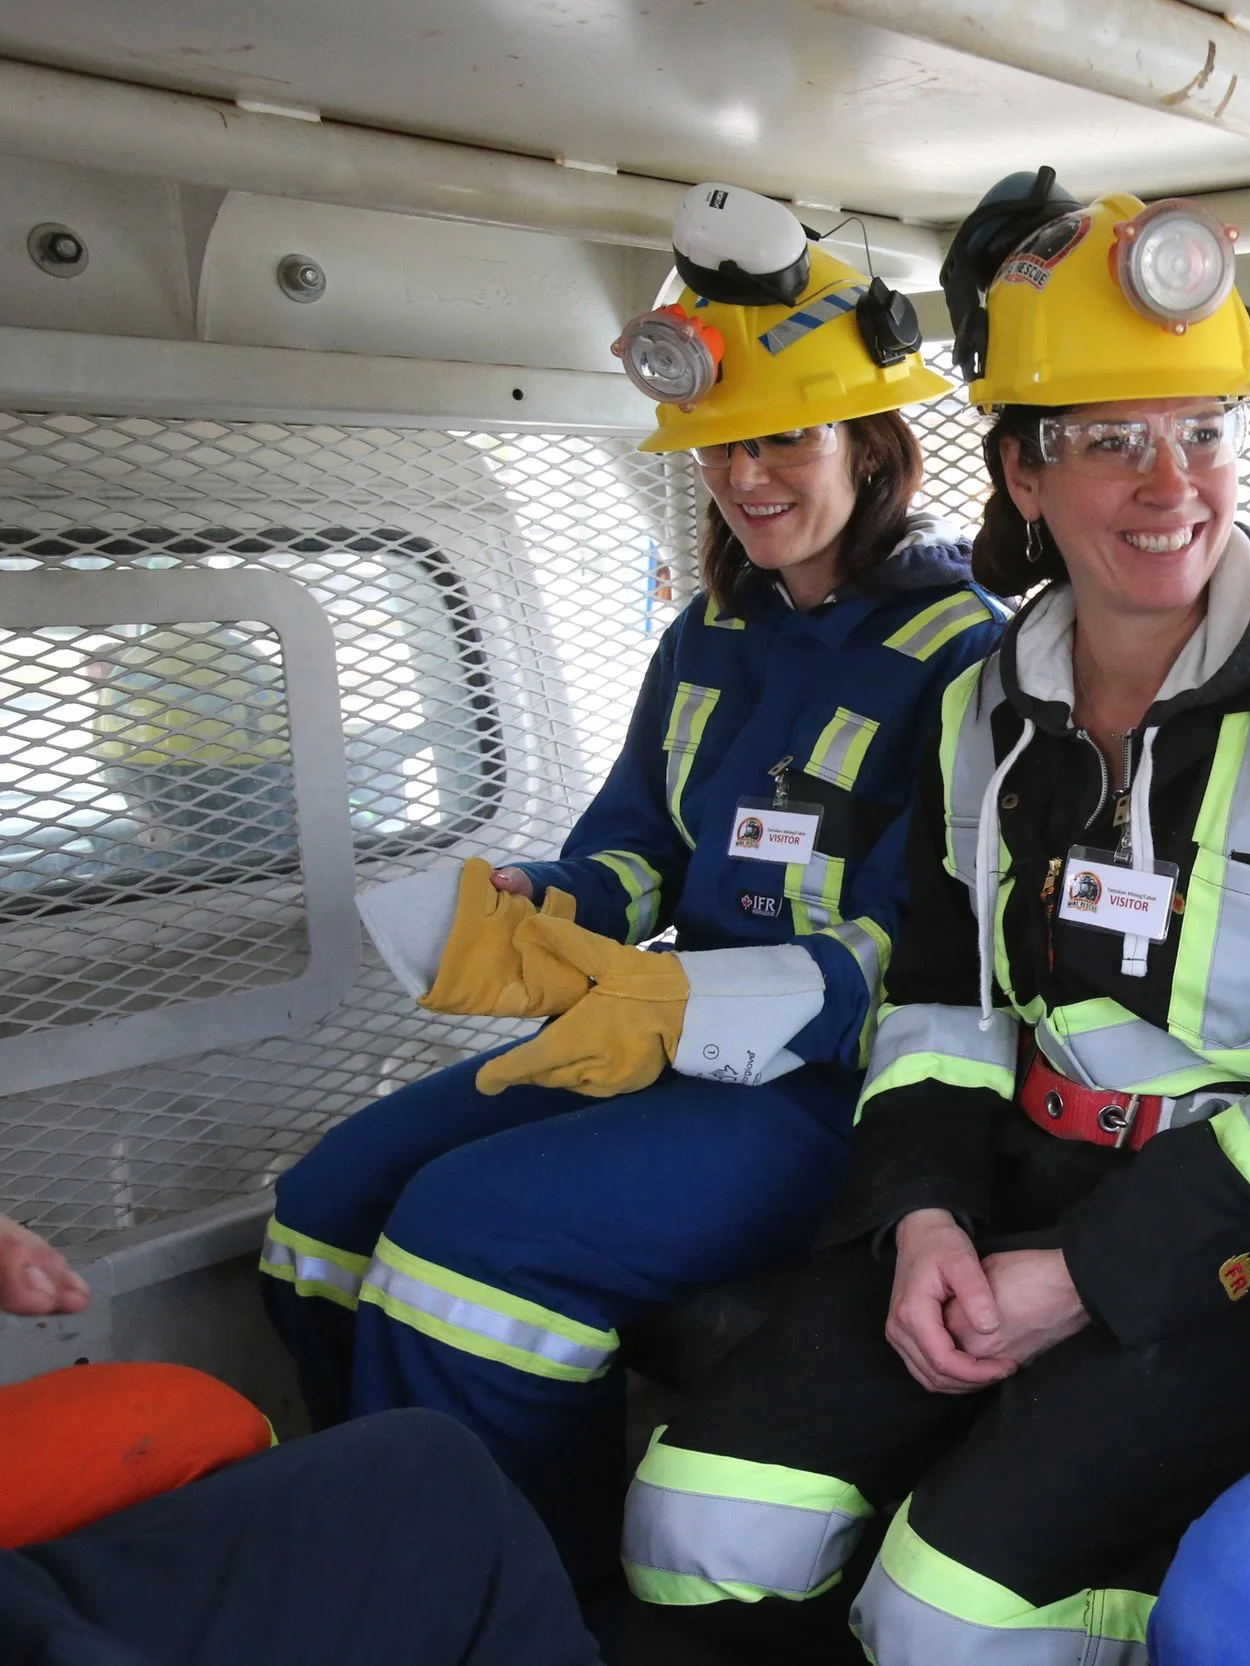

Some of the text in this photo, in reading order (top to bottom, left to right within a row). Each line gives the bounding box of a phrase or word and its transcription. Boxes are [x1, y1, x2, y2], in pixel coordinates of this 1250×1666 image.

[768, 833, 801, 846] VISITOR
[752, 894, 776, 912] IFR
[1109, 894, 1149, 912] VISITOR
[1224, 1262, 1248, 1296] FR
